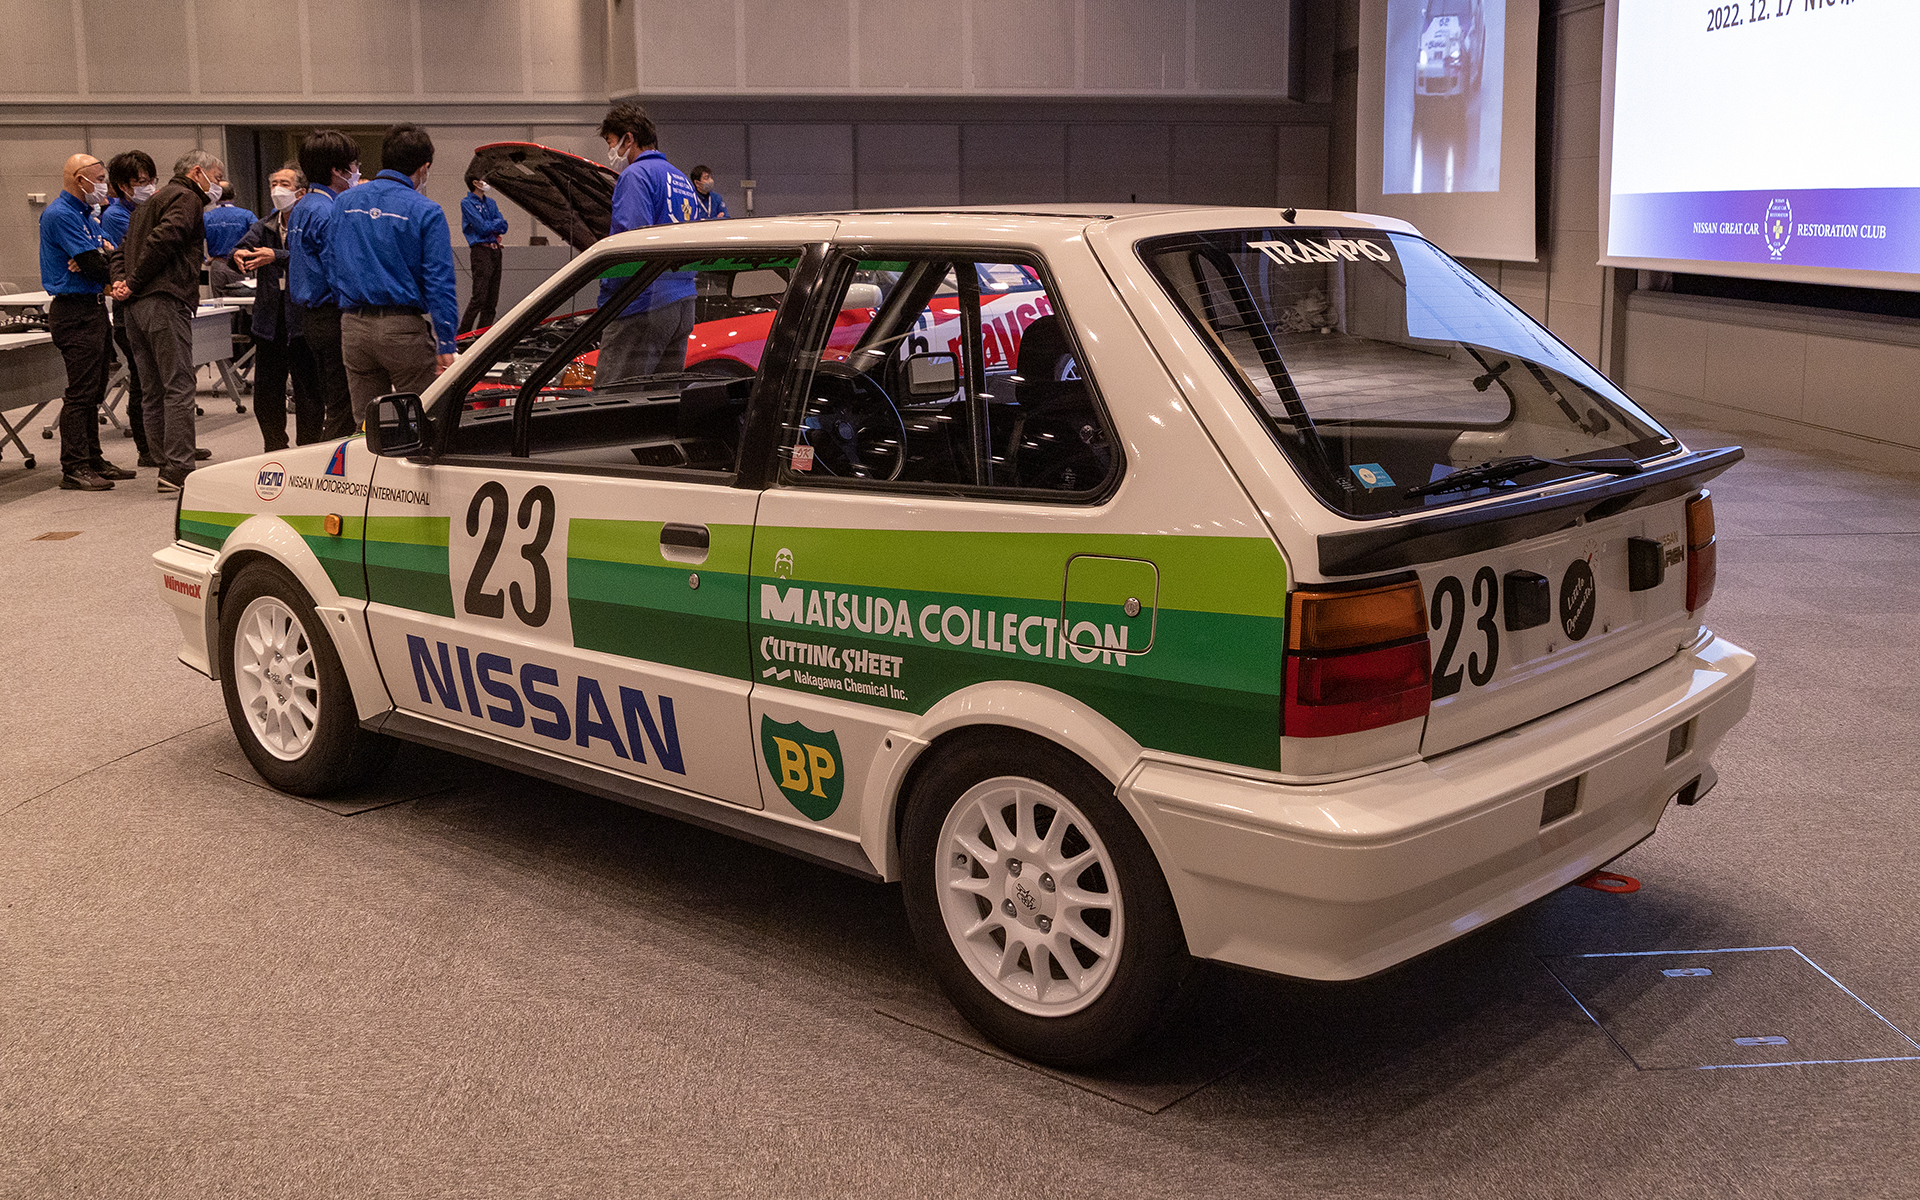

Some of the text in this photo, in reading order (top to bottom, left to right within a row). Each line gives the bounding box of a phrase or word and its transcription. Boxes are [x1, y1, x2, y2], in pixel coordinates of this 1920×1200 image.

[1706, 2, 1744, 32] 2022.
[1749, 0, 1770, 23] 12.
[1693, 222, 1760, 235] NISSAN GREAT CAR
[1797, 223, 1887, 239] RESTORATION CLUB
[288, 475, 430, 506] NISSAN MOTORSPORTS INTERNATIONAL
[463, 480, 556, 628] 23
[760, 583, 1129, 667] MATSUDA COLLECTION
[1430, 565, 1500, 702] 23
[760, 635, 903, 679] CUTTING SHEET
[406, 633, 687, 776] NISSAN
[793, 669, 909, 701] Nakagawa Chemical Inc.
[772, 735, 836, 799] BP
